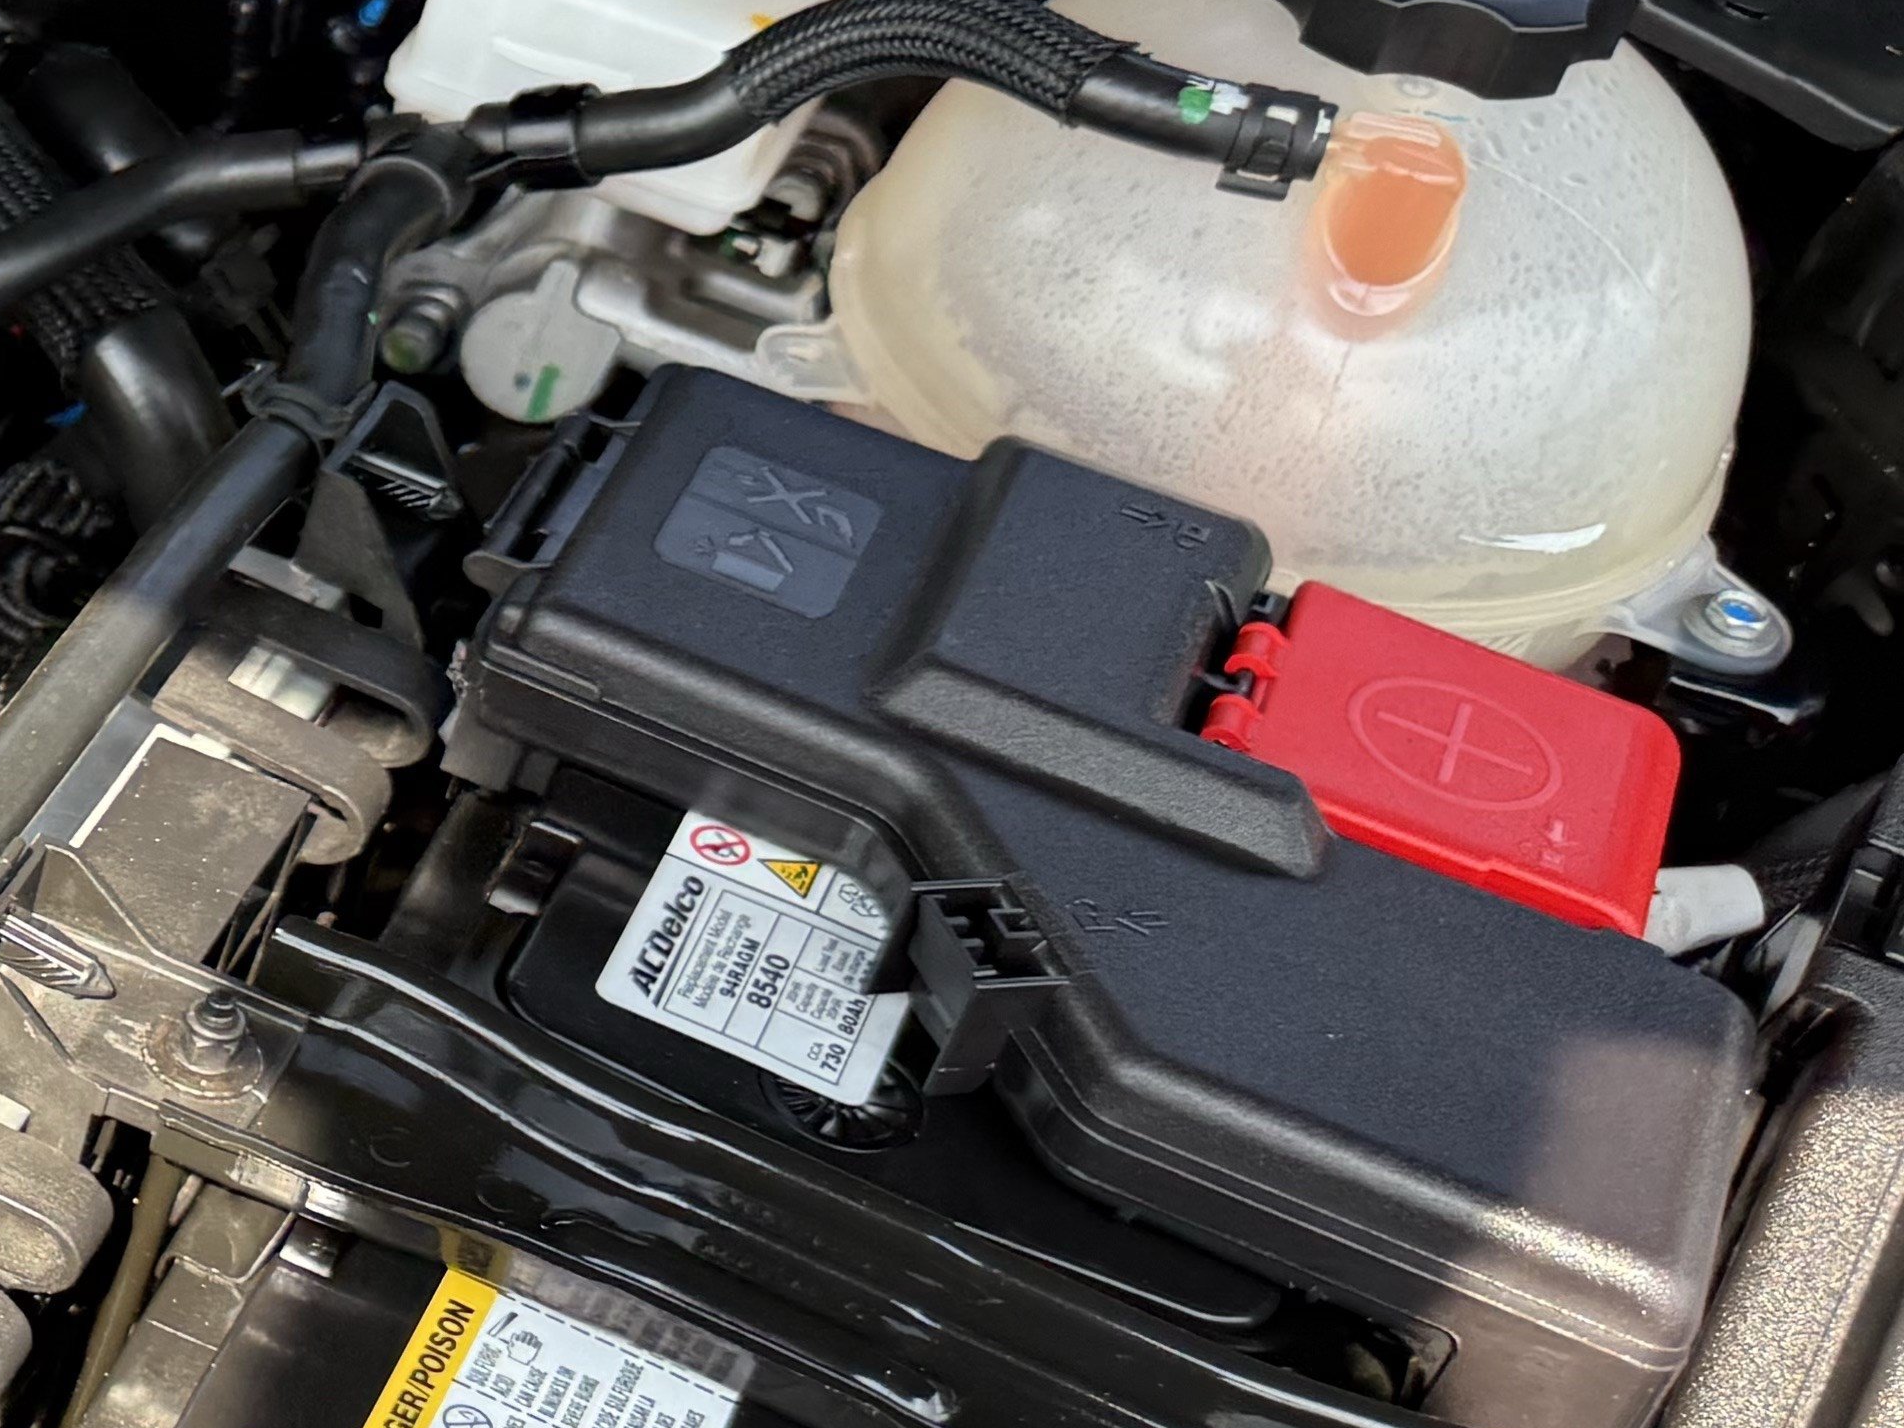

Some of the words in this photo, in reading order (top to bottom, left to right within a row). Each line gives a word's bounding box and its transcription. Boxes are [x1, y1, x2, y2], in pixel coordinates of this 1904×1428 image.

[631, 876, 703, 995] ACDelco
[707, 908, 732, 938] Model
[719, 937, 760, 998] 94RAGM
[746, 953, 789, 1008] 8540
[837, 998, 866, 1035] 80Ah
[806, 1041, 824, 1061] CCA
[819, 1043, 846, 1072] 730
[465, 1342, 502, 1386] SULFURIC
[556, 1365, 575, 1380] OR
[489, 1373, 515, 1397] ACID
[521, 1365, 548, 1393] CAUSE
[604, 1359, 644, 1412] SULFURIQUE
[513, 1389, 536, 1408] CAN
[638, 1394, 655, 1408] LA
